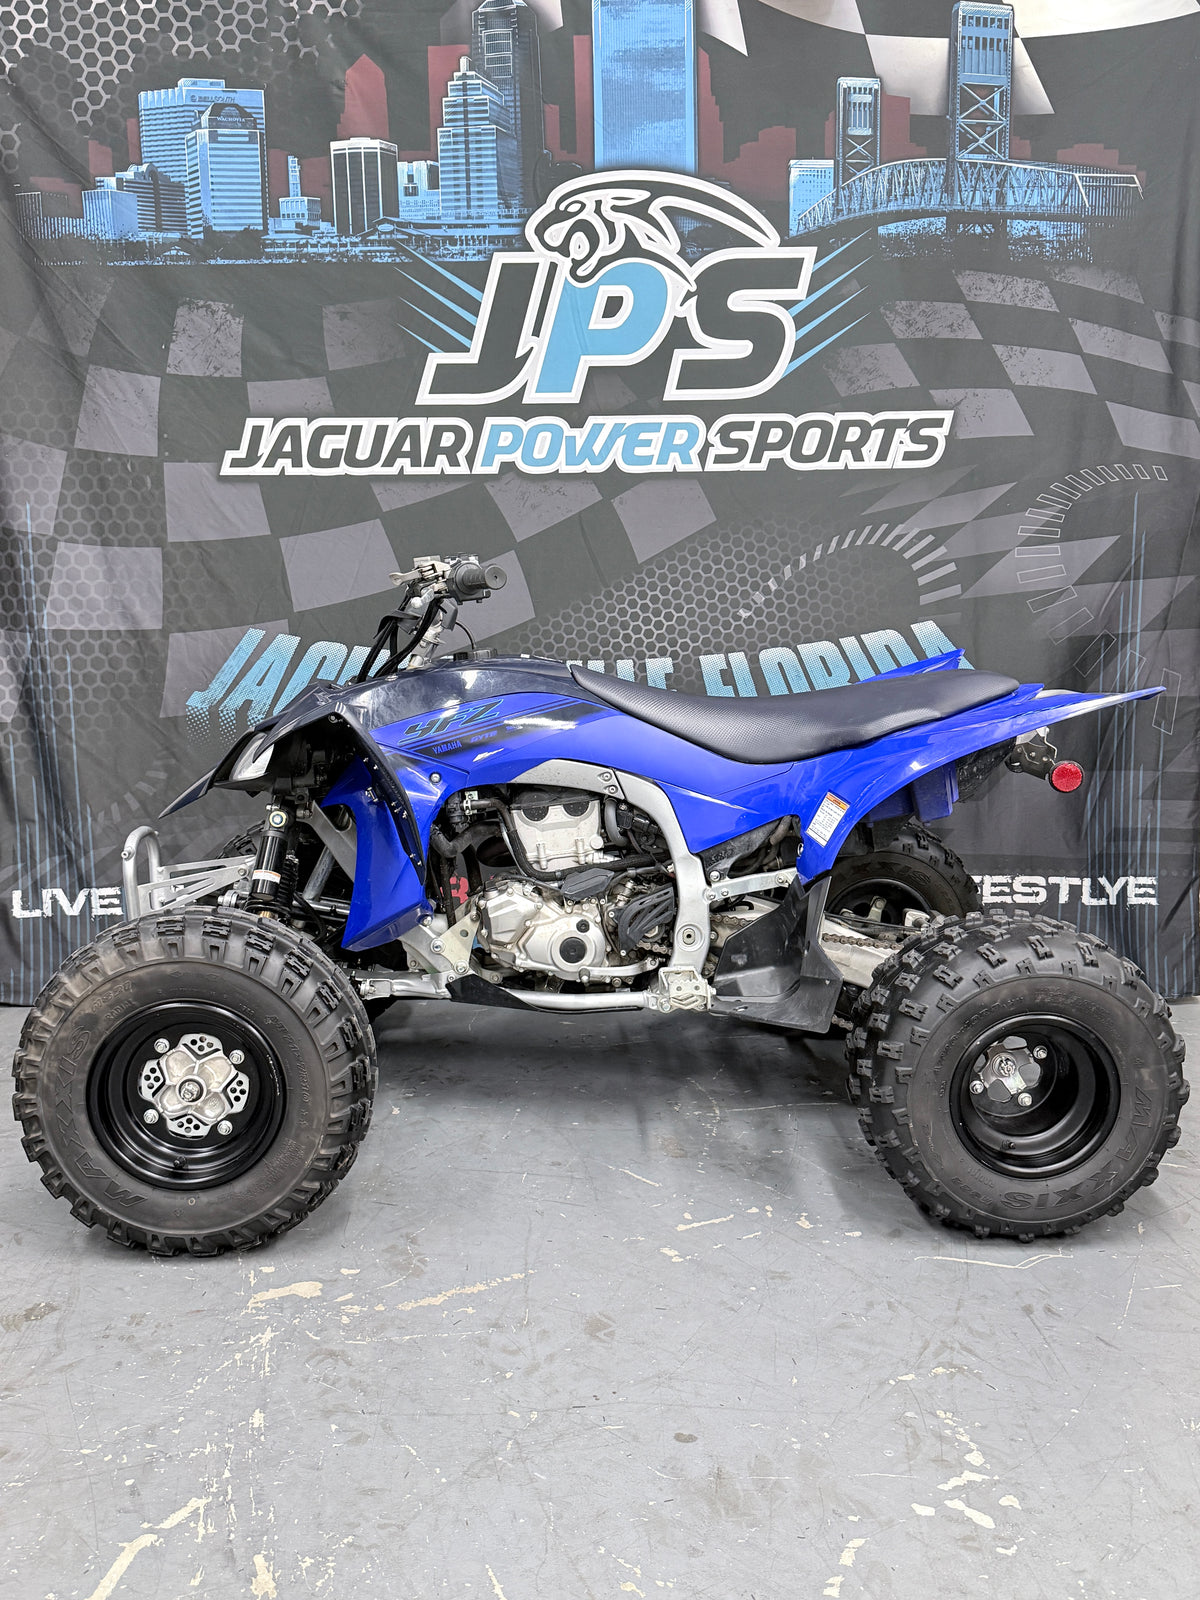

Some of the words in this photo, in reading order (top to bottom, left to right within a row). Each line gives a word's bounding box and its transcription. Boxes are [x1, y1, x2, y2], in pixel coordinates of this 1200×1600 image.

[416, 247, 816, 404] JPS
[222, 417, 472, 475] JAGUAR
[472, 416, 704, 474] POWER
[705, 411, 953, 472] SPORTS
[432, 740, 463, 755] YAMAHA
[11, 886, 125, 920] LIVE
[55, 1025, 149, 1208] MAXXIS
[1001, 1086, 1153, 1210] MAXXIS
